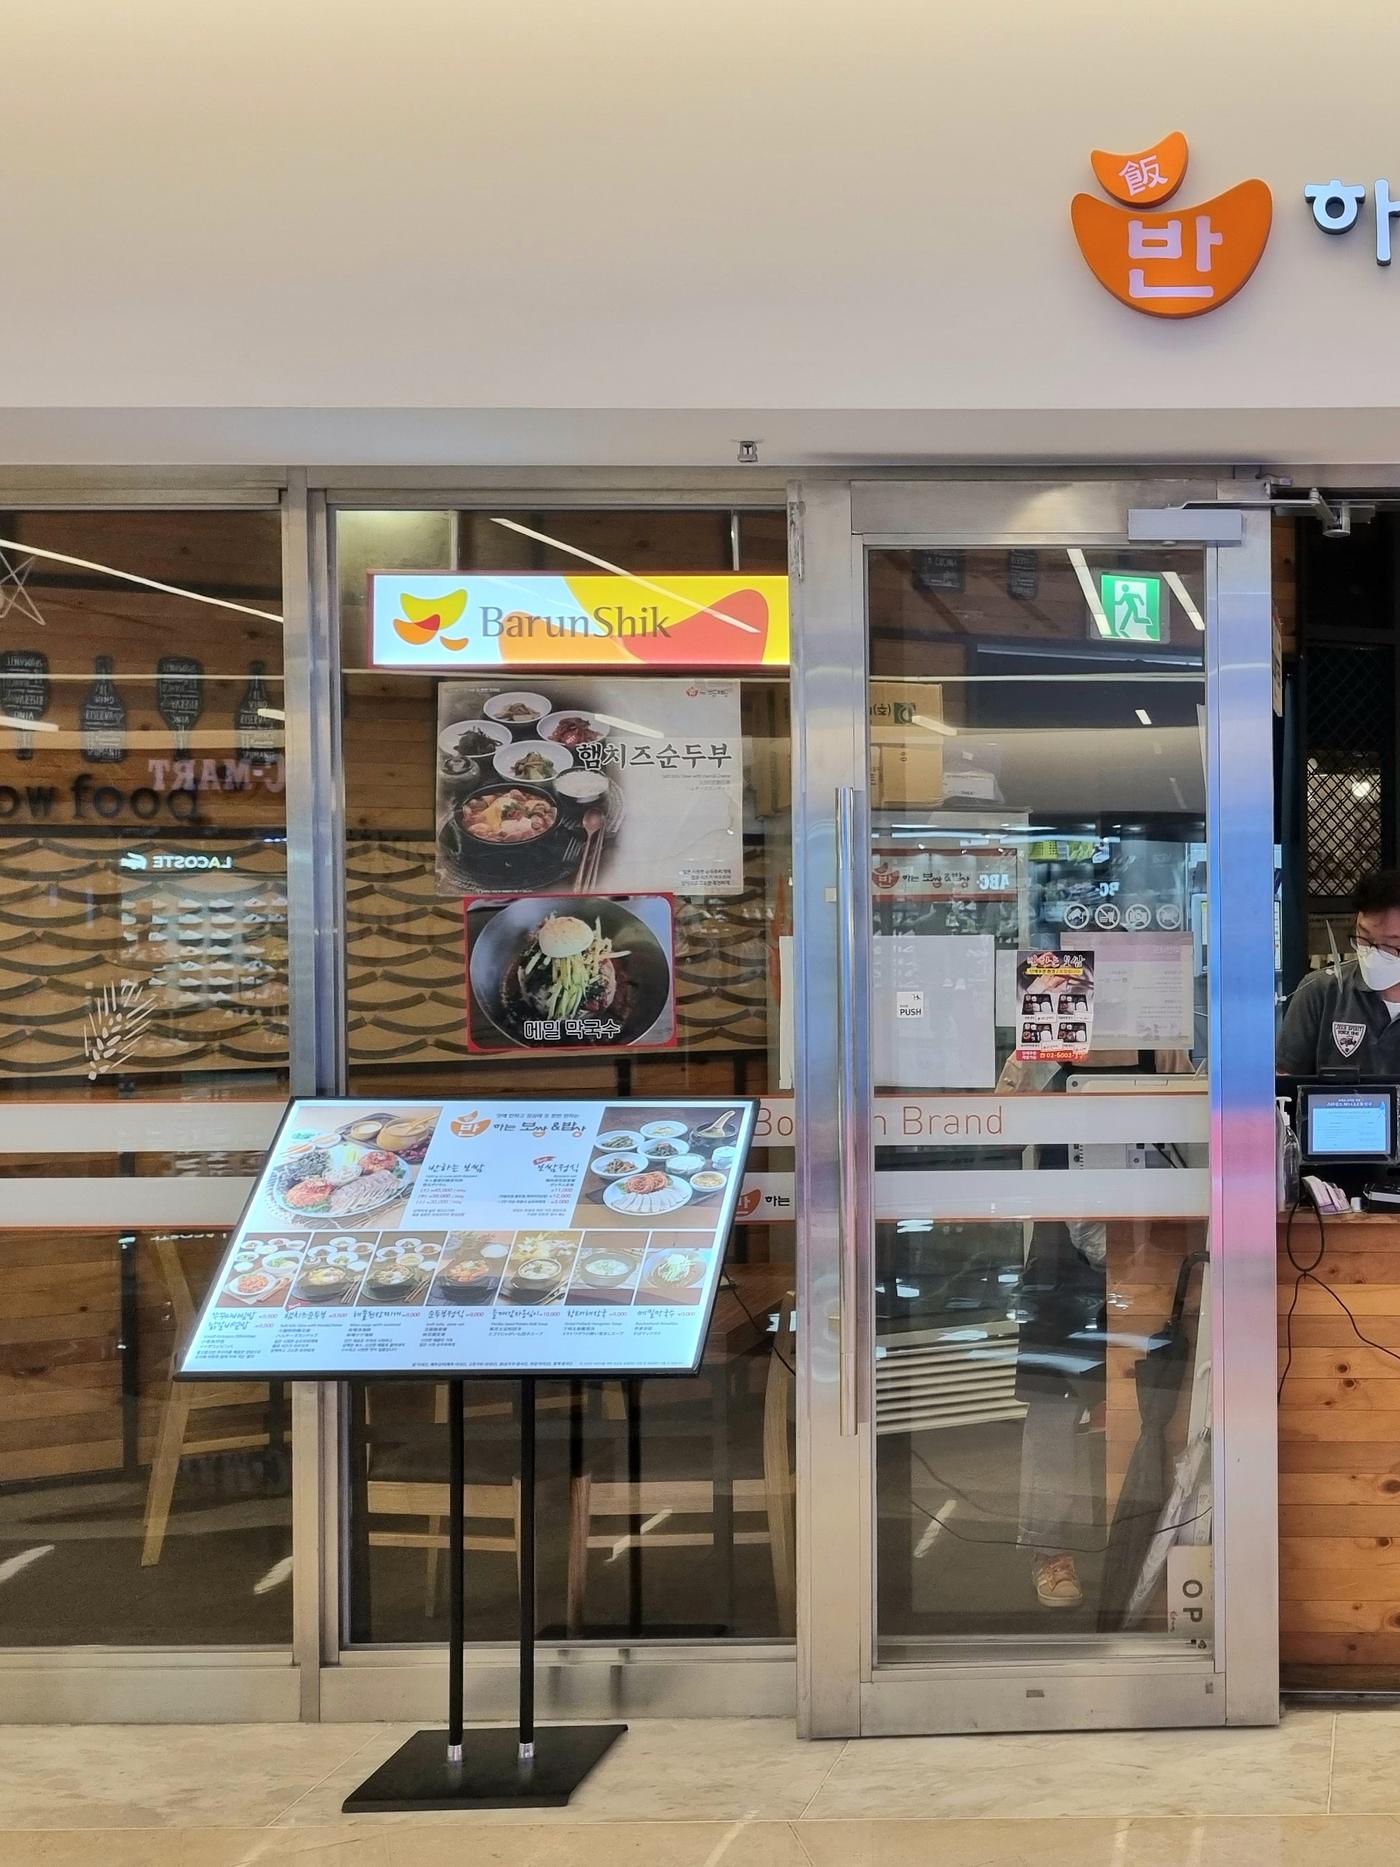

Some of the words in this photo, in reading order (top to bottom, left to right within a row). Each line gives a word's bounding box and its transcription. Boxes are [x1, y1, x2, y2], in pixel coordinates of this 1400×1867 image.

[1118, 154, 1169, 197] 飯
[479, 605, 673, 638] BarunShik
[575, 740, 733, 771] 햄치즈순두부
[899, 1008, 922, 1016] PUSH
[523, 1019, 562, 1041] 메밀
[564, 1018, 621, 1040] 막국수
[902, 1105, 1003, 1136] Brand
[764, 1195, 791, 1207] 하는
[1182, 1579, 1204, 1623] OP
